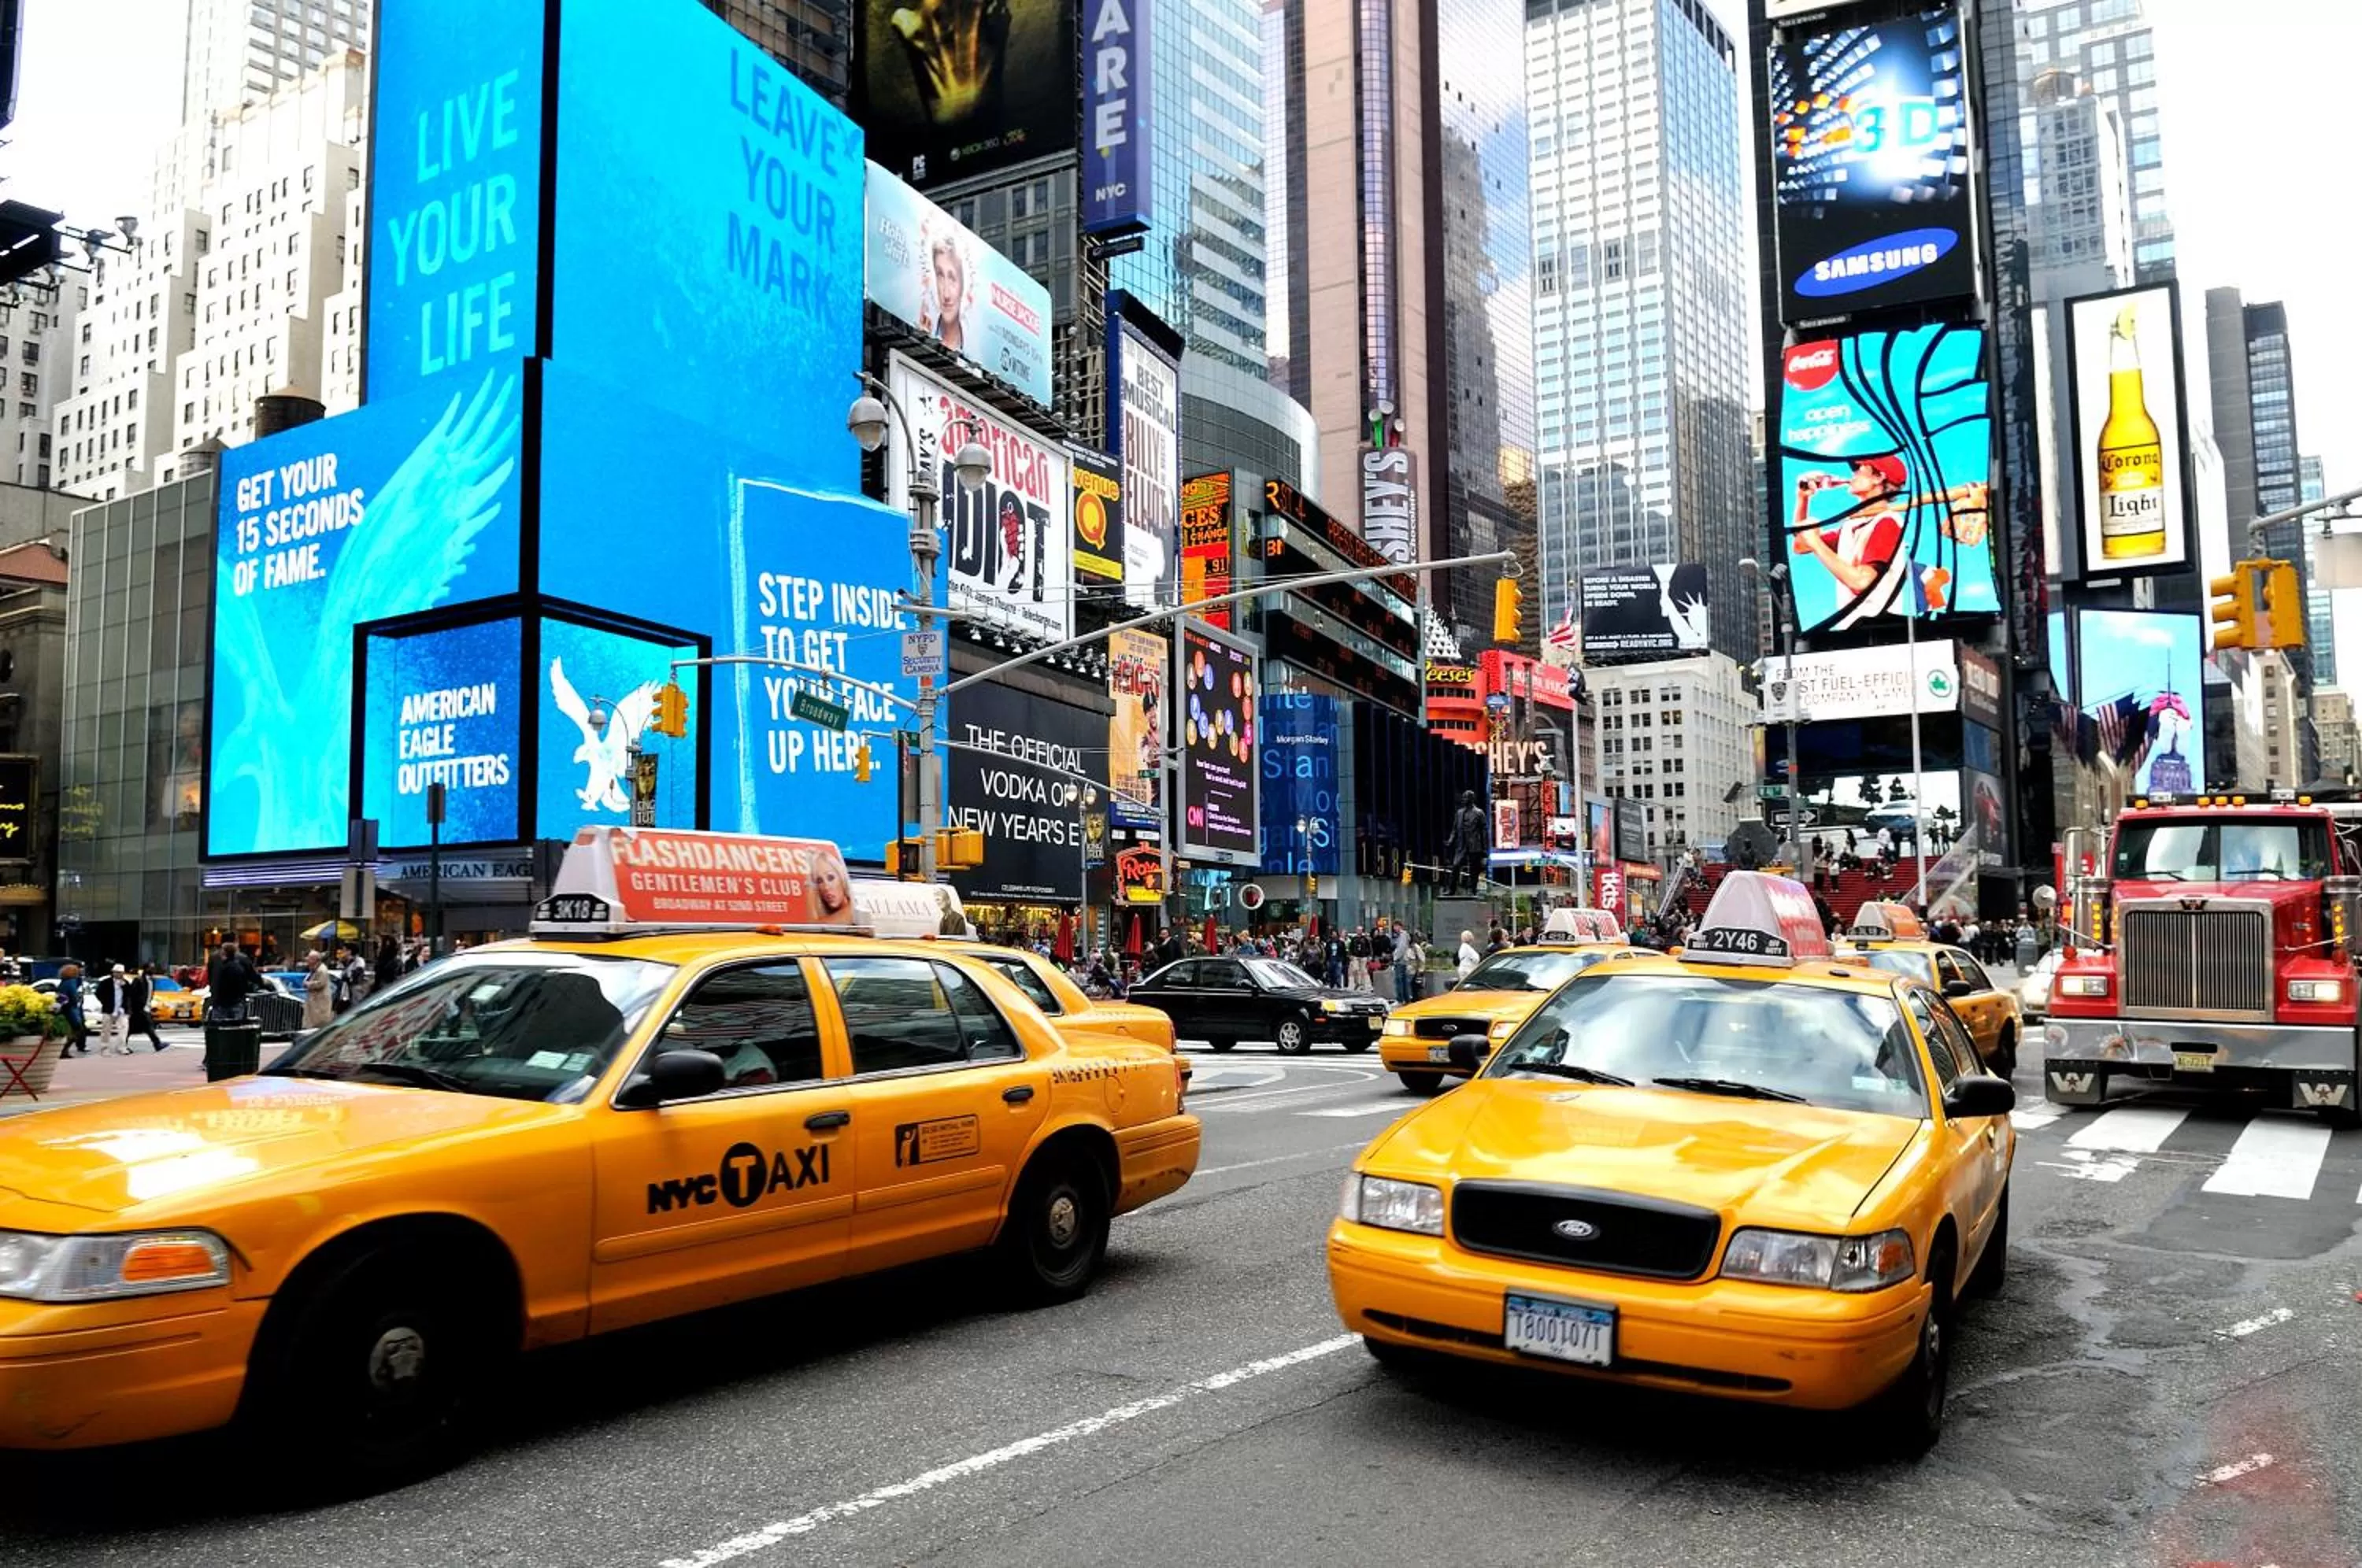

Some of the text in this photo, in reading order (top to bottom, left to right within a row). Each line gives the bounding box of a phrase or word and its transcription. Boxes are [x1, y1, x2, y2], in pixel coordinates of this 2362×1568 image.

[416, 69, 520, 183] LIVE
[729, 47, 839, 179] LEAVE
[1853, 100, 1939, 153] 3D
[740, 135, 836, 255] YOUR
[1095, 182, 1126, 202] NYC
[388, 172, 516, 287] YOUR
[727, 211, 835, 317] MARK
[1814, 243, 1938, 282] SAMSUNG
[420, 272, 516, 376] LIFE
[1136, 363, 1164, 401] BEST
[1124, 377, 1175, 435] MUSICAL
[1804, 403, 1851, 422] open
[919, 427, 936, 472] AY'S
[1125, 409, 1161, 482] BILLY
[1787, 419, 1871, 444] happiness
[2101, 451, 2160, 473] Corona
[237, 453, 338, 513] GET YOUR
[1072, 467, 1120, 502] venue
[236, 487, 365, 555] 15 SECONDS
[1075, 490, 1107, 550] Q
[1363, 451, 1409, 565] SHEY'S
[2108, 493, 2158, 519] Light
[235, 543, 326, 597] OF FAME.
[759, 571, 824, 621] STEP
[831, 582, 907, 631] INSIDE
[761, 625, 848, 675] TO GET
[908, 634, 937, 645] NYPD
[1775, 664, 1836, 680] FOM THE
[1799, 671, 1912, 693] ST FUEL-EFFICI
[399, 682, 496, 727] AMERICAN
[798, 698, 840, 726] Broadway
[842, 679, 897, 723] FACE
[398, 723, 455, 760] EAGLE
[768, 729, 805, 775] UP
[964, 723, 1086, 774] THE OFFICIAL
[1466, 741, 1547, 775] HEY'S
[398, 754, 510, 795] OUTFITTERS
[980, 767, 1047, 804] VODKA
[947, 805, 996, 838] NEW
[1001, 812, 1065, 845] YEAR'S
[491, 863, 534, 878] EAG
[610, 838, 814, 875] FLASHDANCERS
[631, 871, 802, 897] GENTLEMEN'S CLUB
[1601, 871, 1620, 909] tkts
[553, 900, 590, 920] 3K18
[653, 897, 712, 911] BROADWAY
[755, 901, 788, 913] STREET
[1713, 930, 1758, 951] 2Y46
[647, 1143, 830, 1215] NYC TAXI
